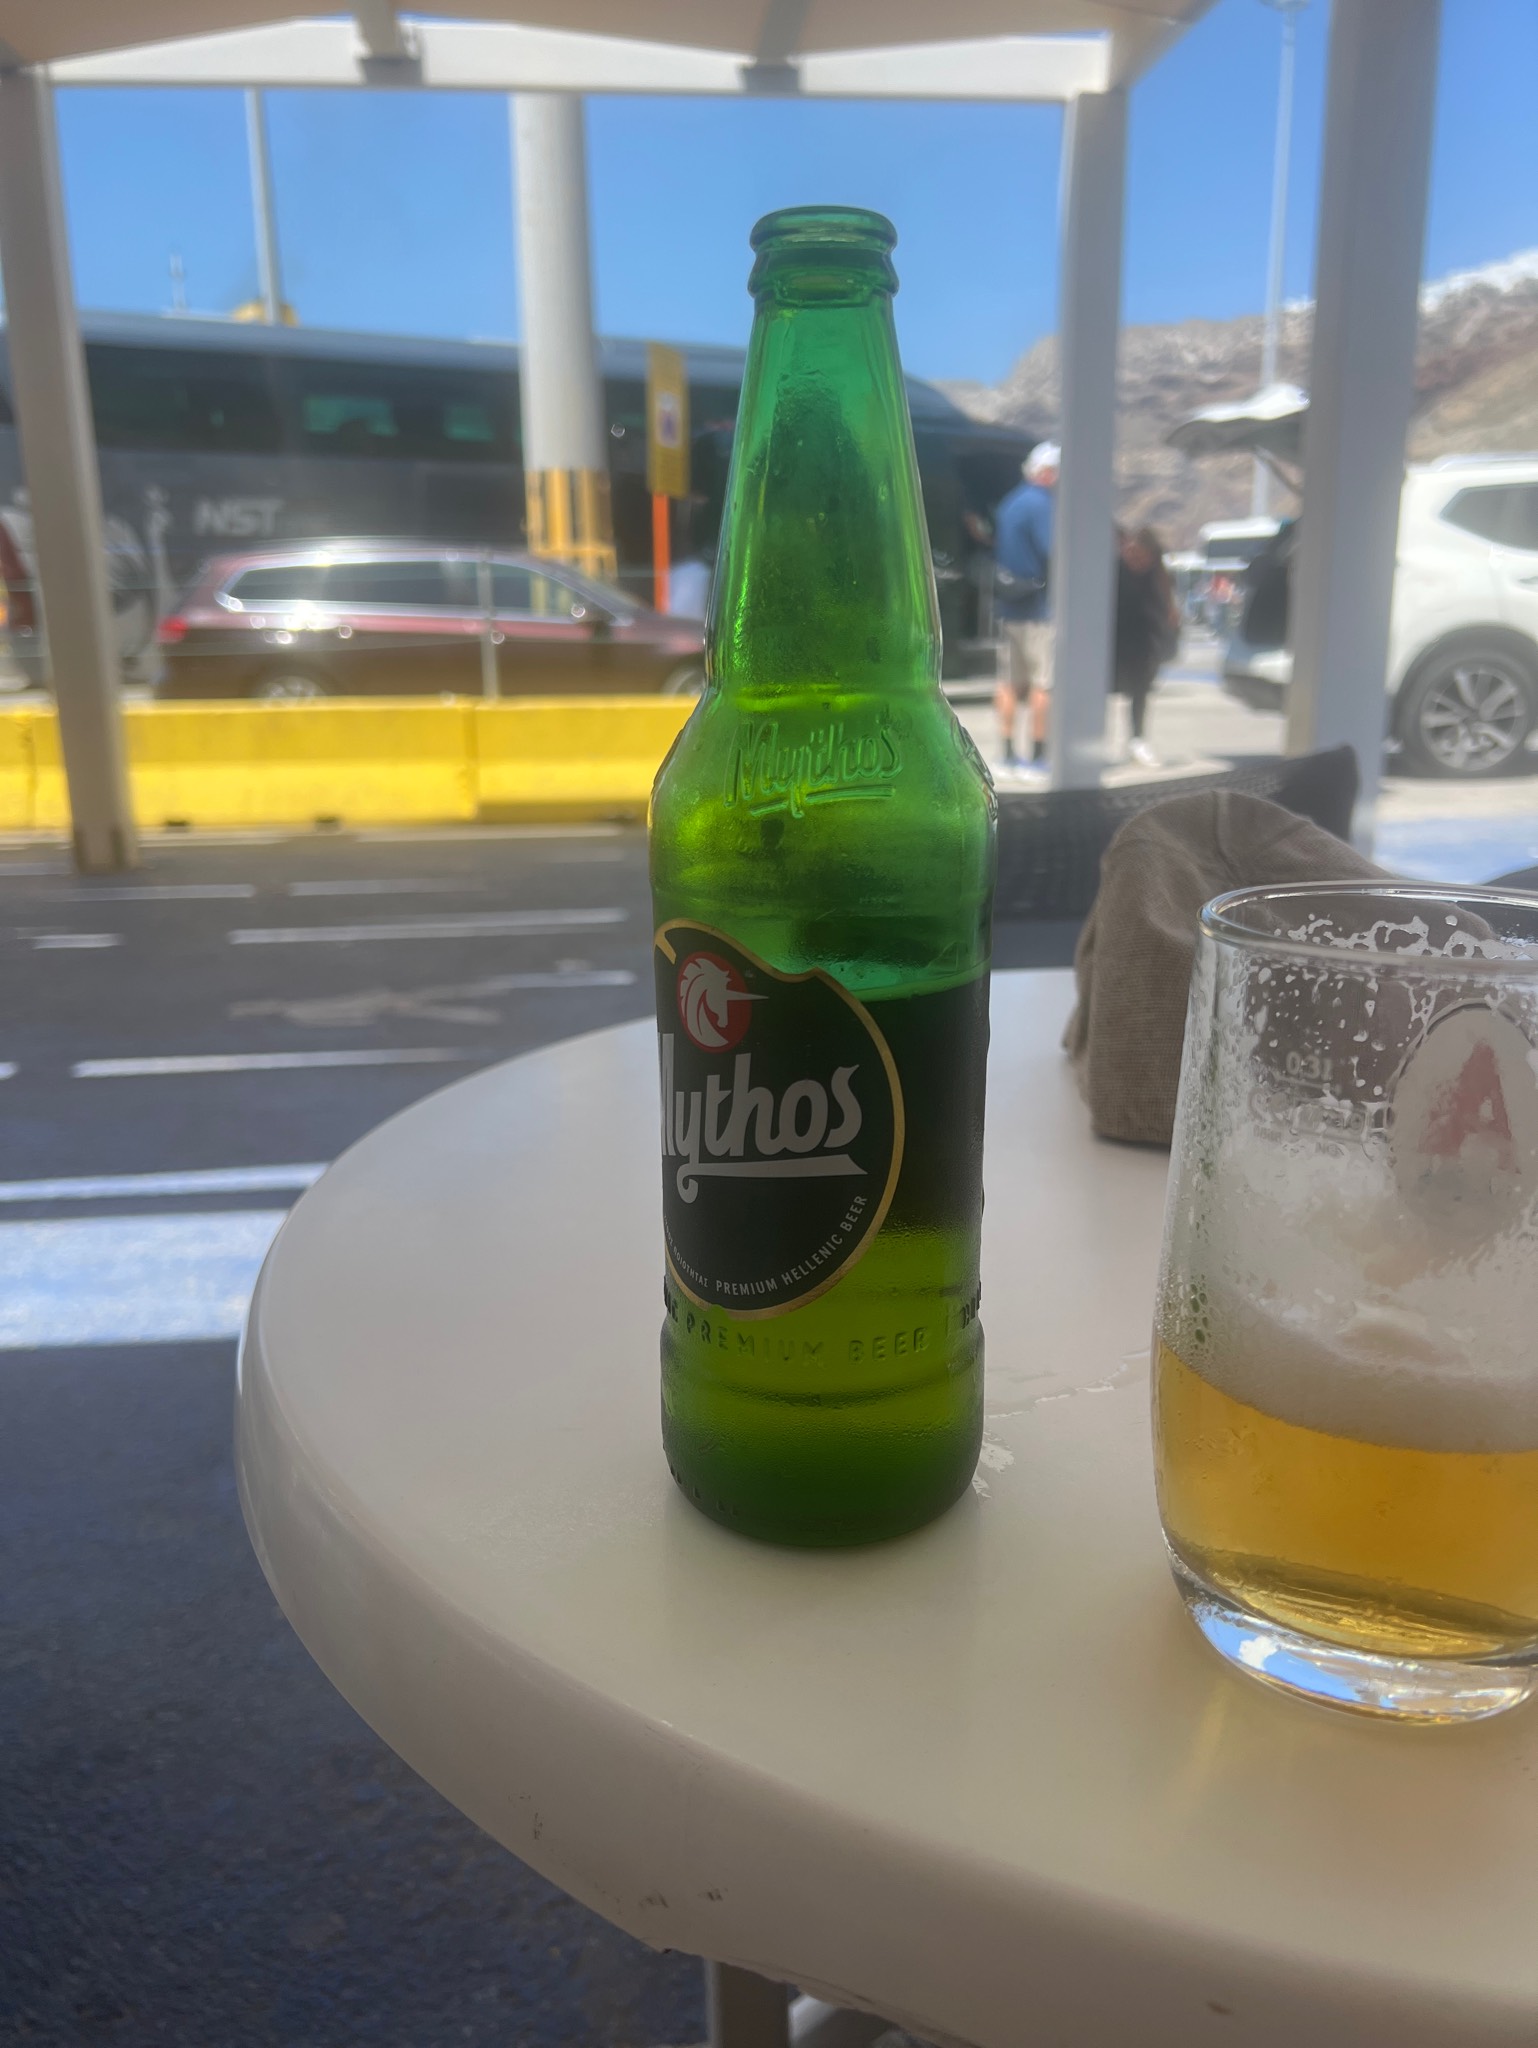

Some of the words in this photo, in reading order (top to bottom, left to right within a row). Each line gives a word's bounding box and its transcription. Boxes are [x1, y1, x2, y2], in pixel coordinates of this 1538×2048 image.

[723, 721, 904, 819] Mythos
[716, 1279, 778, 1296] PREMIUM
[781, 1234, 843, 1286] HELLENIC
[840, 1195, 868, 1232] BEER
[686, 1312, 825, 1367] PREMIUM
[849, 1326, 930, 1365] BEER
